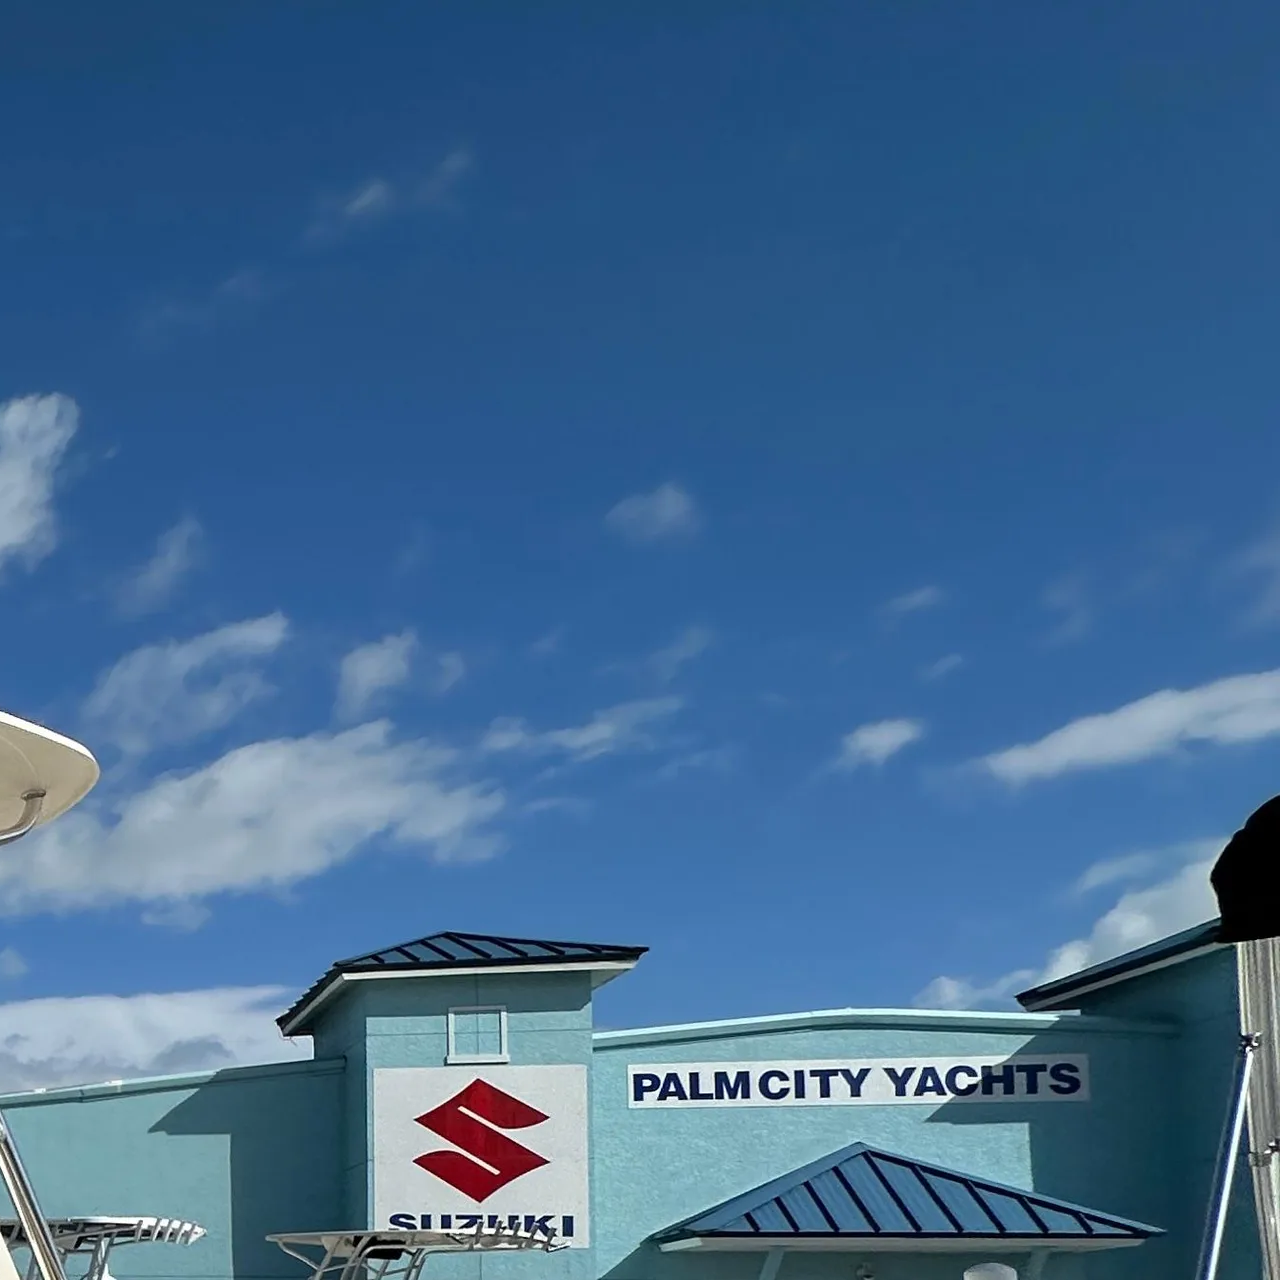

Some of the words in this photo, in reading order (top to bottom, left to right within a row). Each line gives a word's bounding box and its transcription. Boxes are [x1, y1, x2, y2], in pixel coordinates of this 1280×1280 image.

[633, 1071, 750, 1101] PALM
[758, 1068, 871, 1100] CITY
[882, 1063, 1081, 1096] YACHTS
